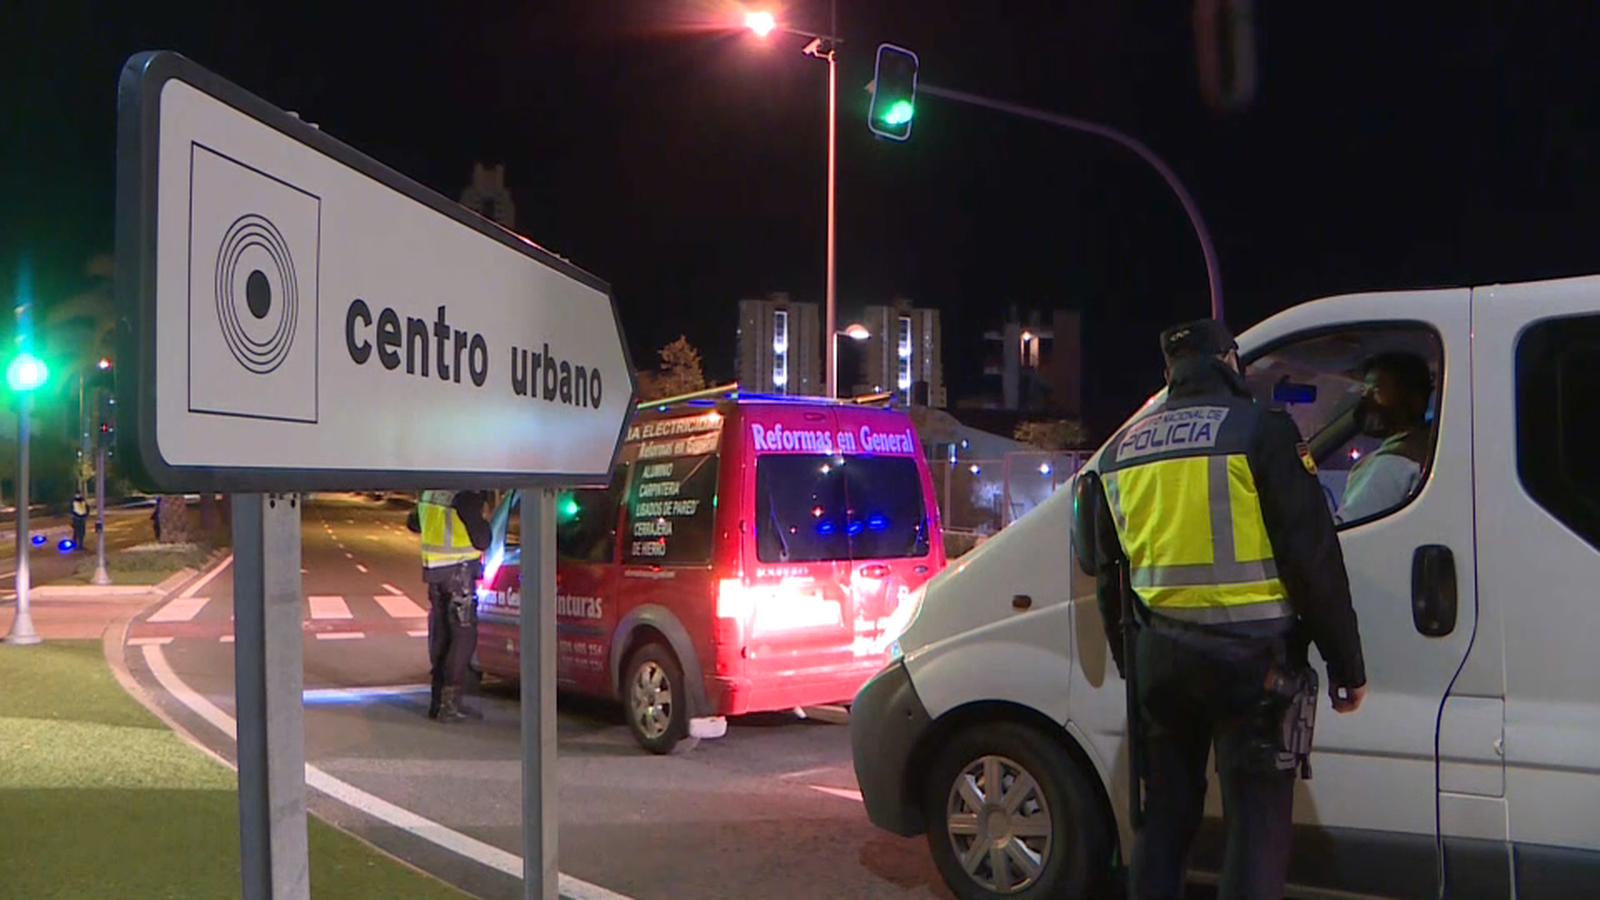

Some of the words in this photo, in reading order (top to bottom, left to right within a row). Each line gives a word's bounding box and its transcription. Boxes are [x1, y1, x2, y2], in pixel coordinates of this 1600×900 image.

[345, 298, 488, 387] centro
[511, 343, 603, 410] urbano
[640, 441, 673, 458] Reformas
[674, 442, 685, 457] en
[750, 423, 832, 451] Reformas
[836, 429, 857, 451] en
[860, 425, 914, 453] General
[1120, 422, 1211, 455] POLICIA
[556, 593, 603, 619] nturas
